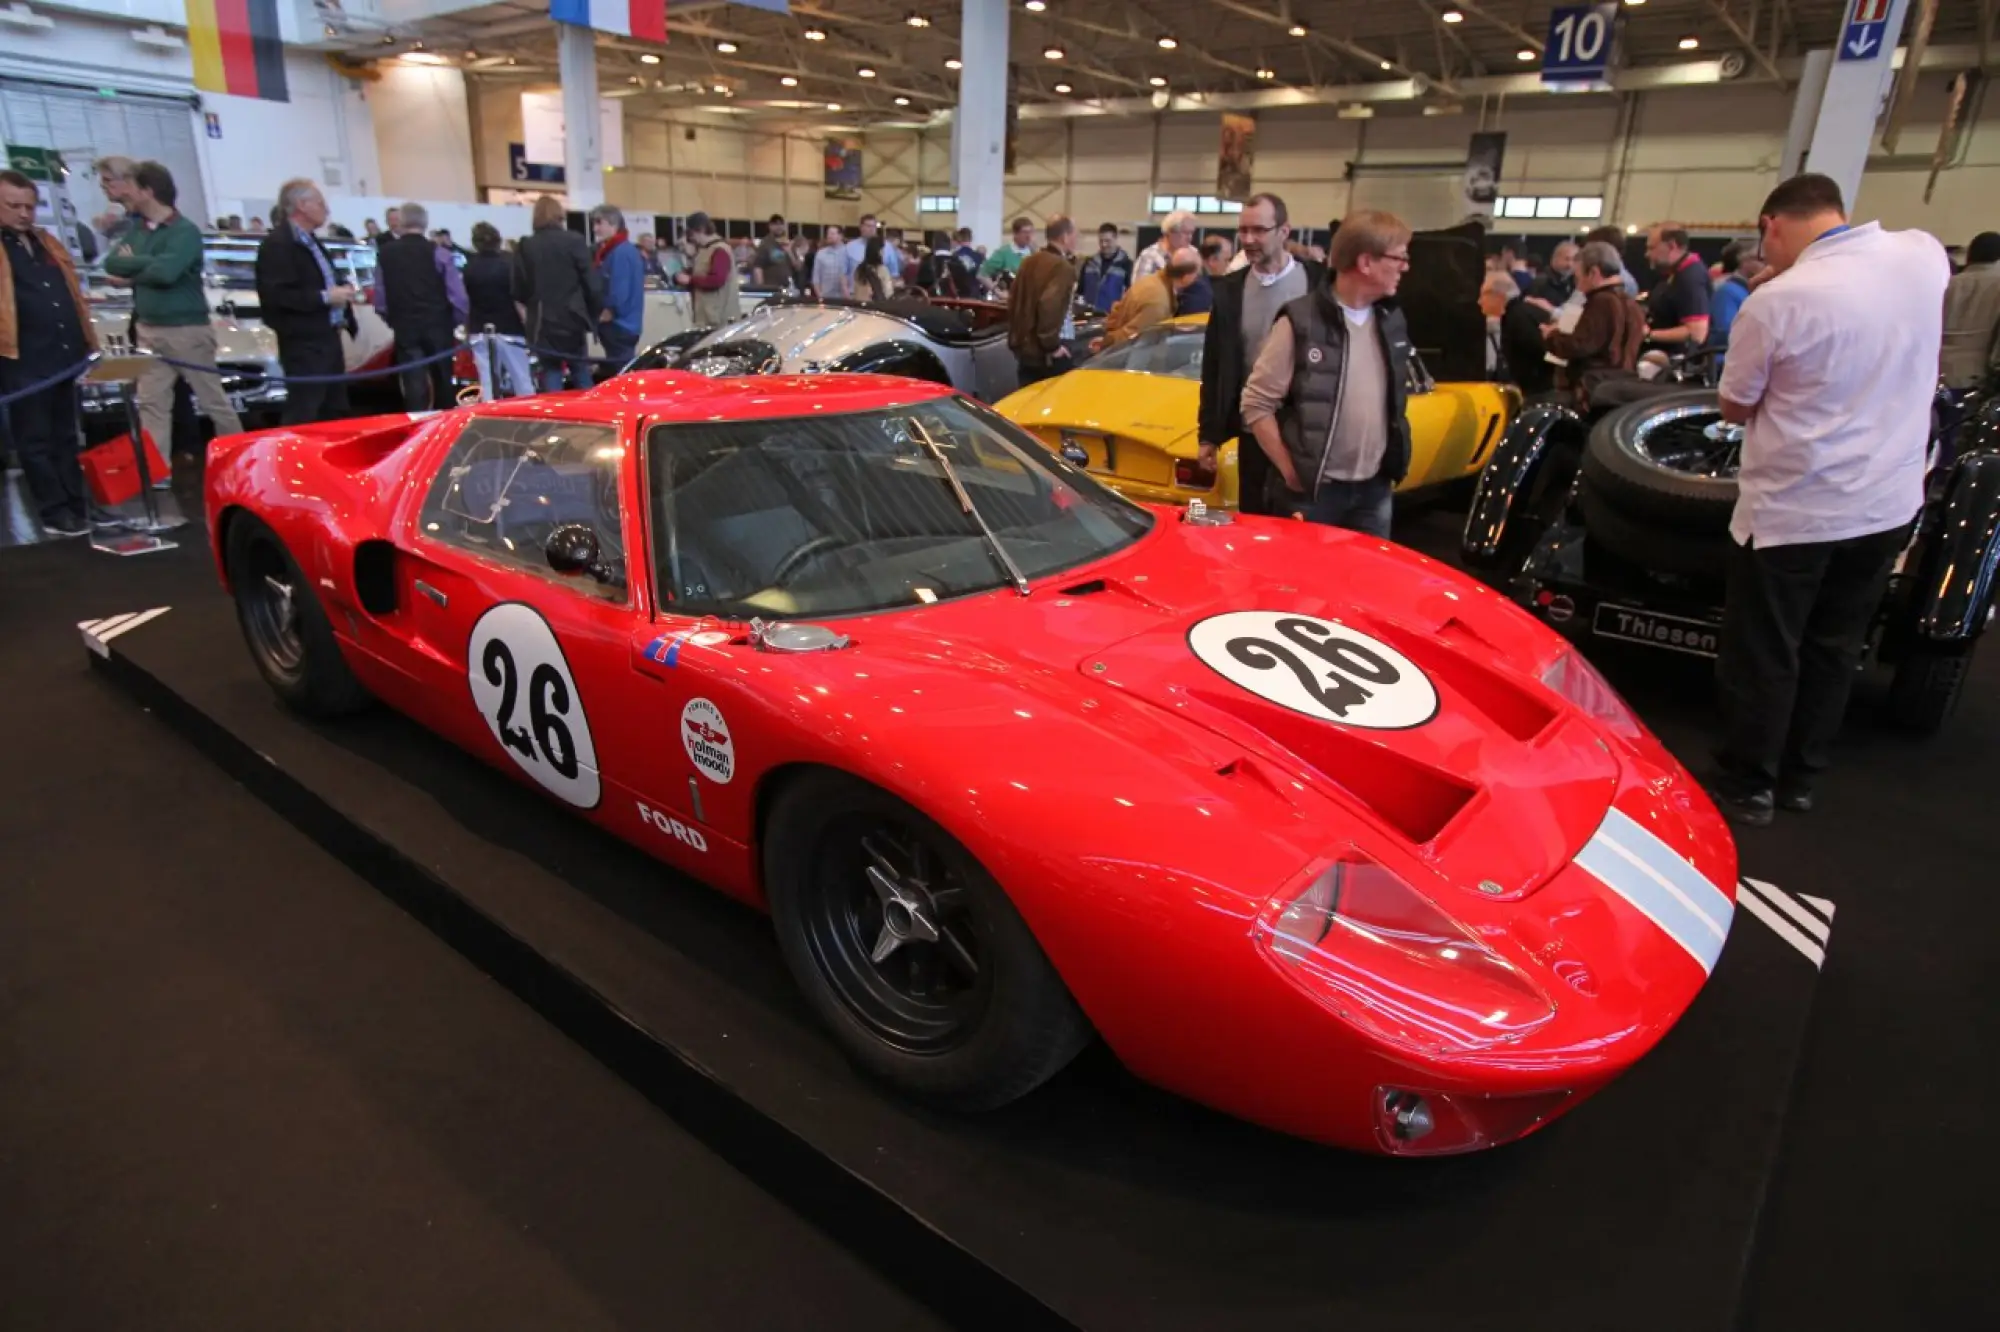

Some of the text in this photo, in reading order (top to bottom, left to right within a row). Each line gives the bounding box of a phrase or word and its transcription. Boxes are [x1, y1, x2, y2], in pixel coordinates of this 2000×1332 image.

[1554, 12, 1605, 61] 10
[1617, 613, 1717, 650] Thiesen
[1225, 618, 1401, 718] 26
[482, 638, 579, 780] 26
[687, 733, 729, 764] holman
[636, 801, 708, 852] FORD
